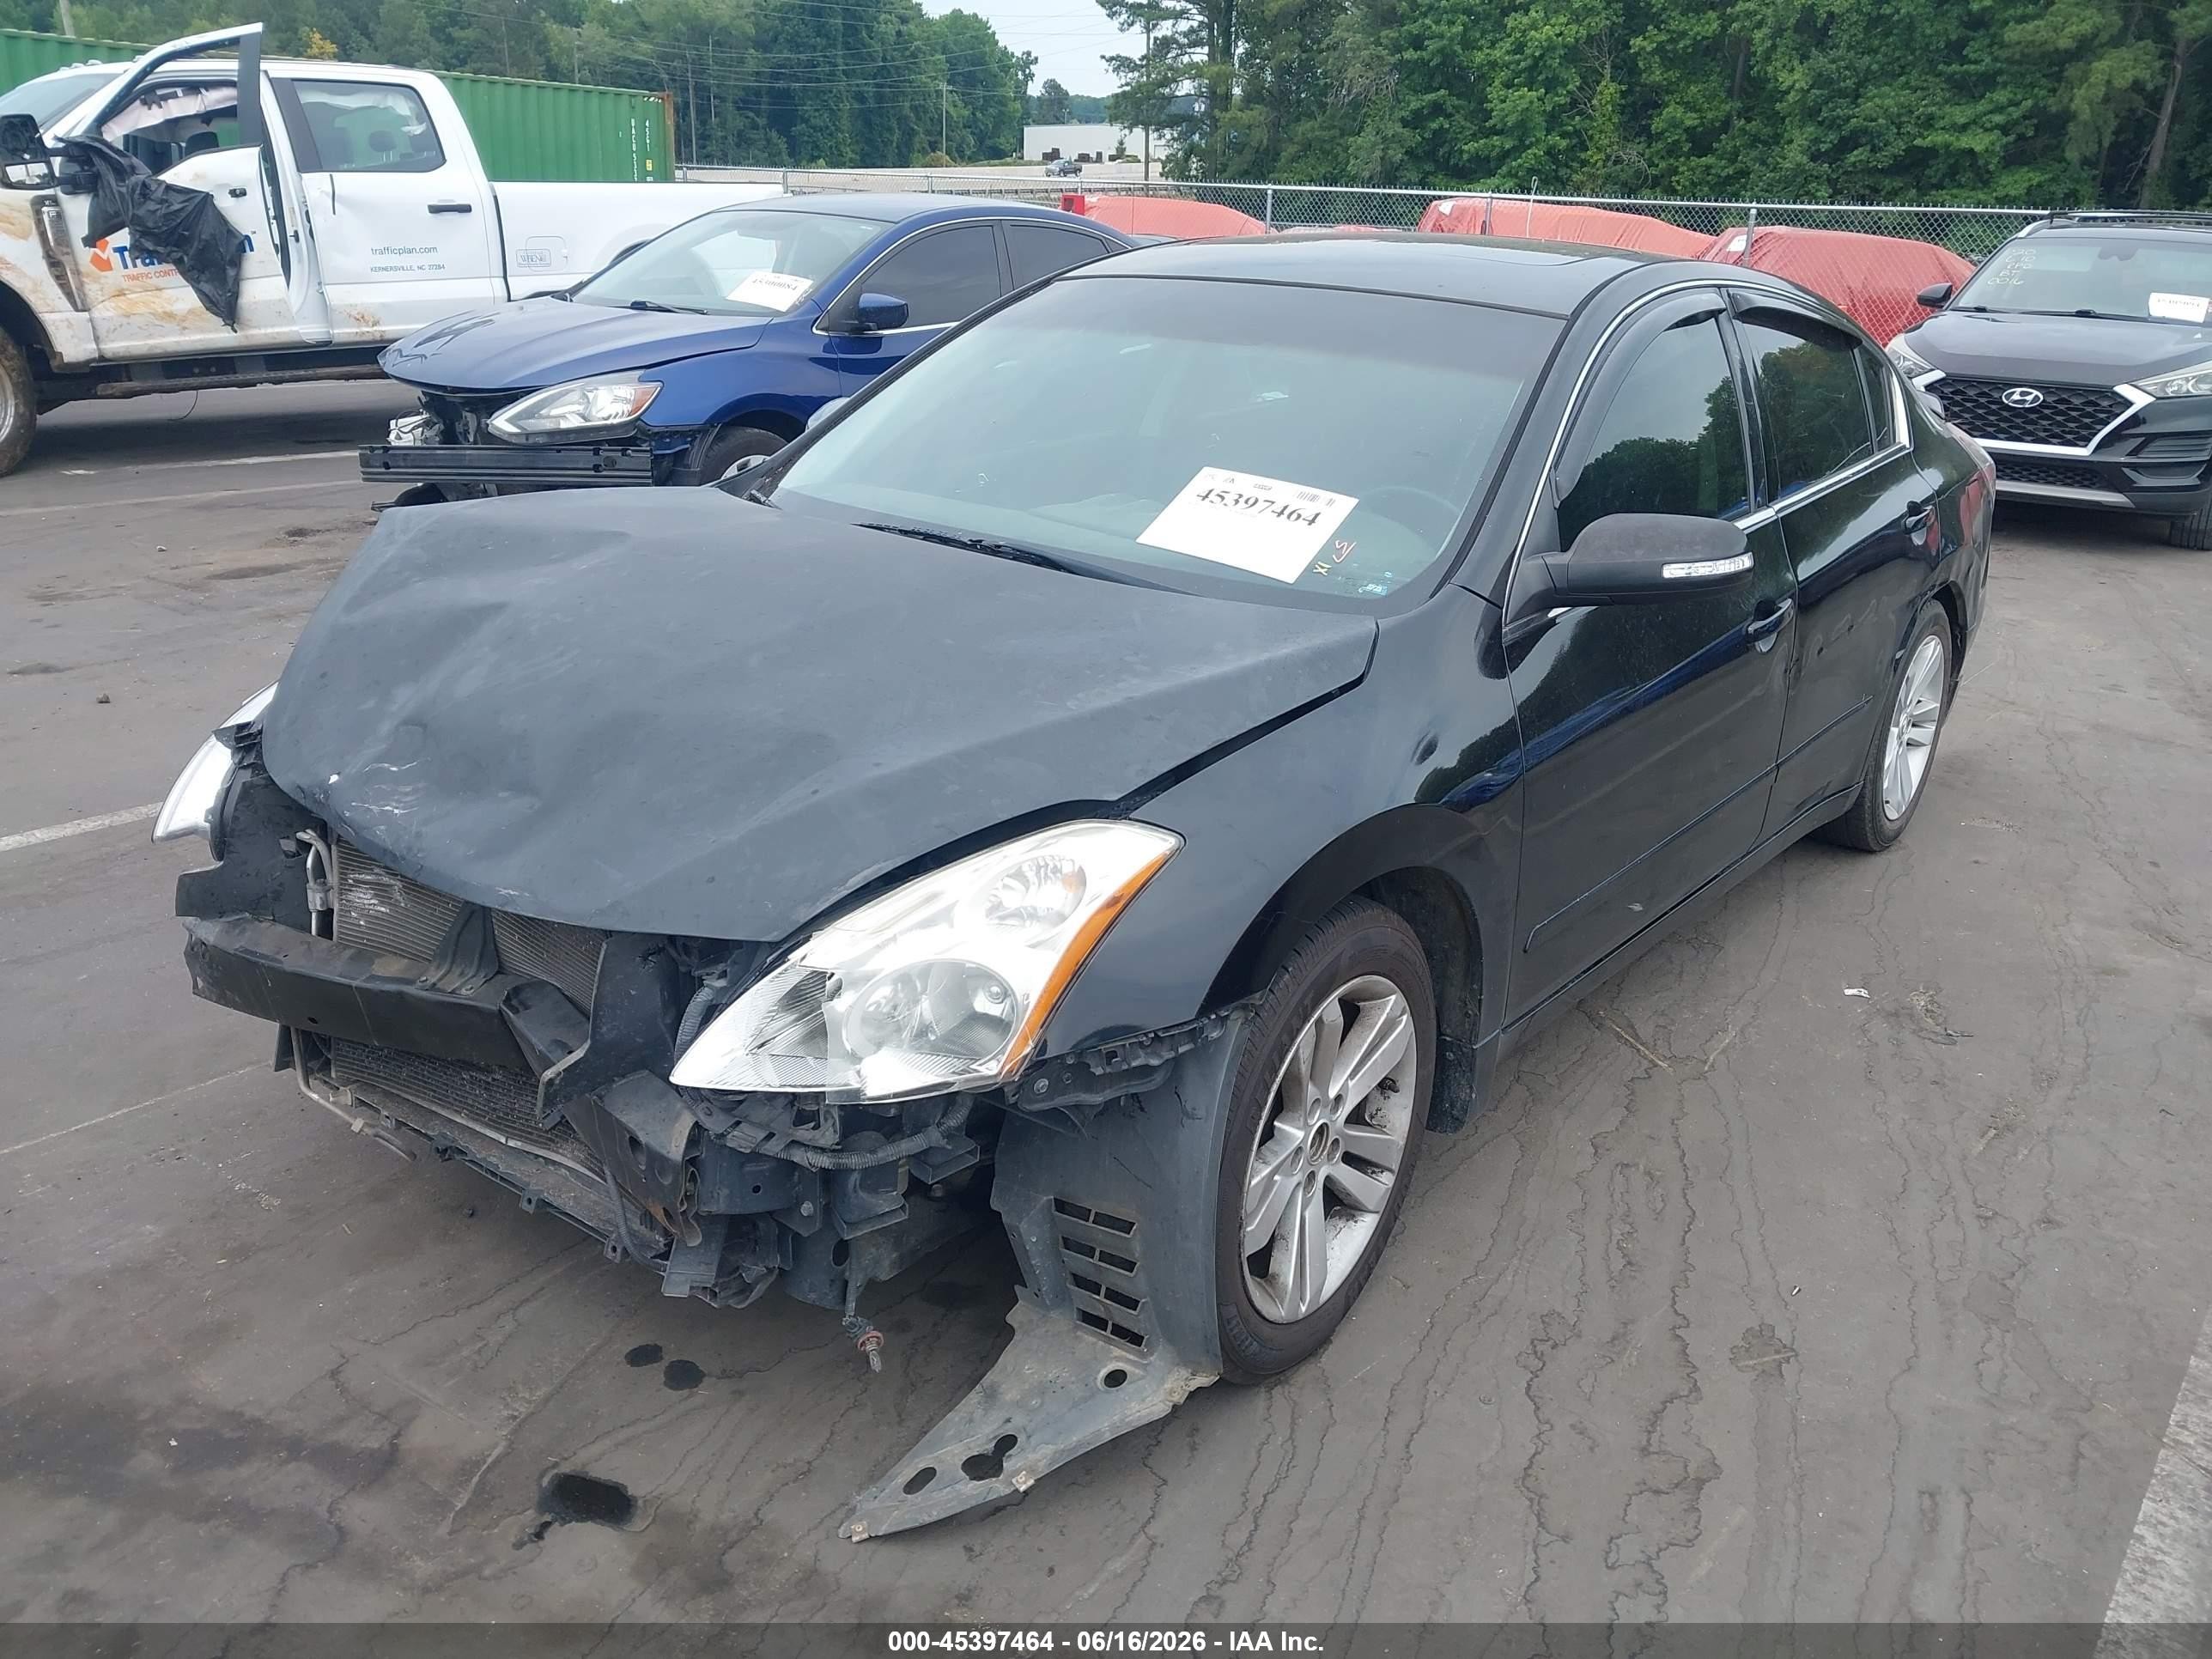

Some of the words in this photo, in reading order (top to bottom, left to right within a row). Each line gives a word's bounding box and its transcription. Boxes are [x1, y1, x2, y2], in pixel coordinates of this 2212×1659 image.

[370, 246, 438, 257] trafficplan.com
[123, 270, 153, 283] TRAFFIC
[1196, 488, 1322, 526] 45397464
